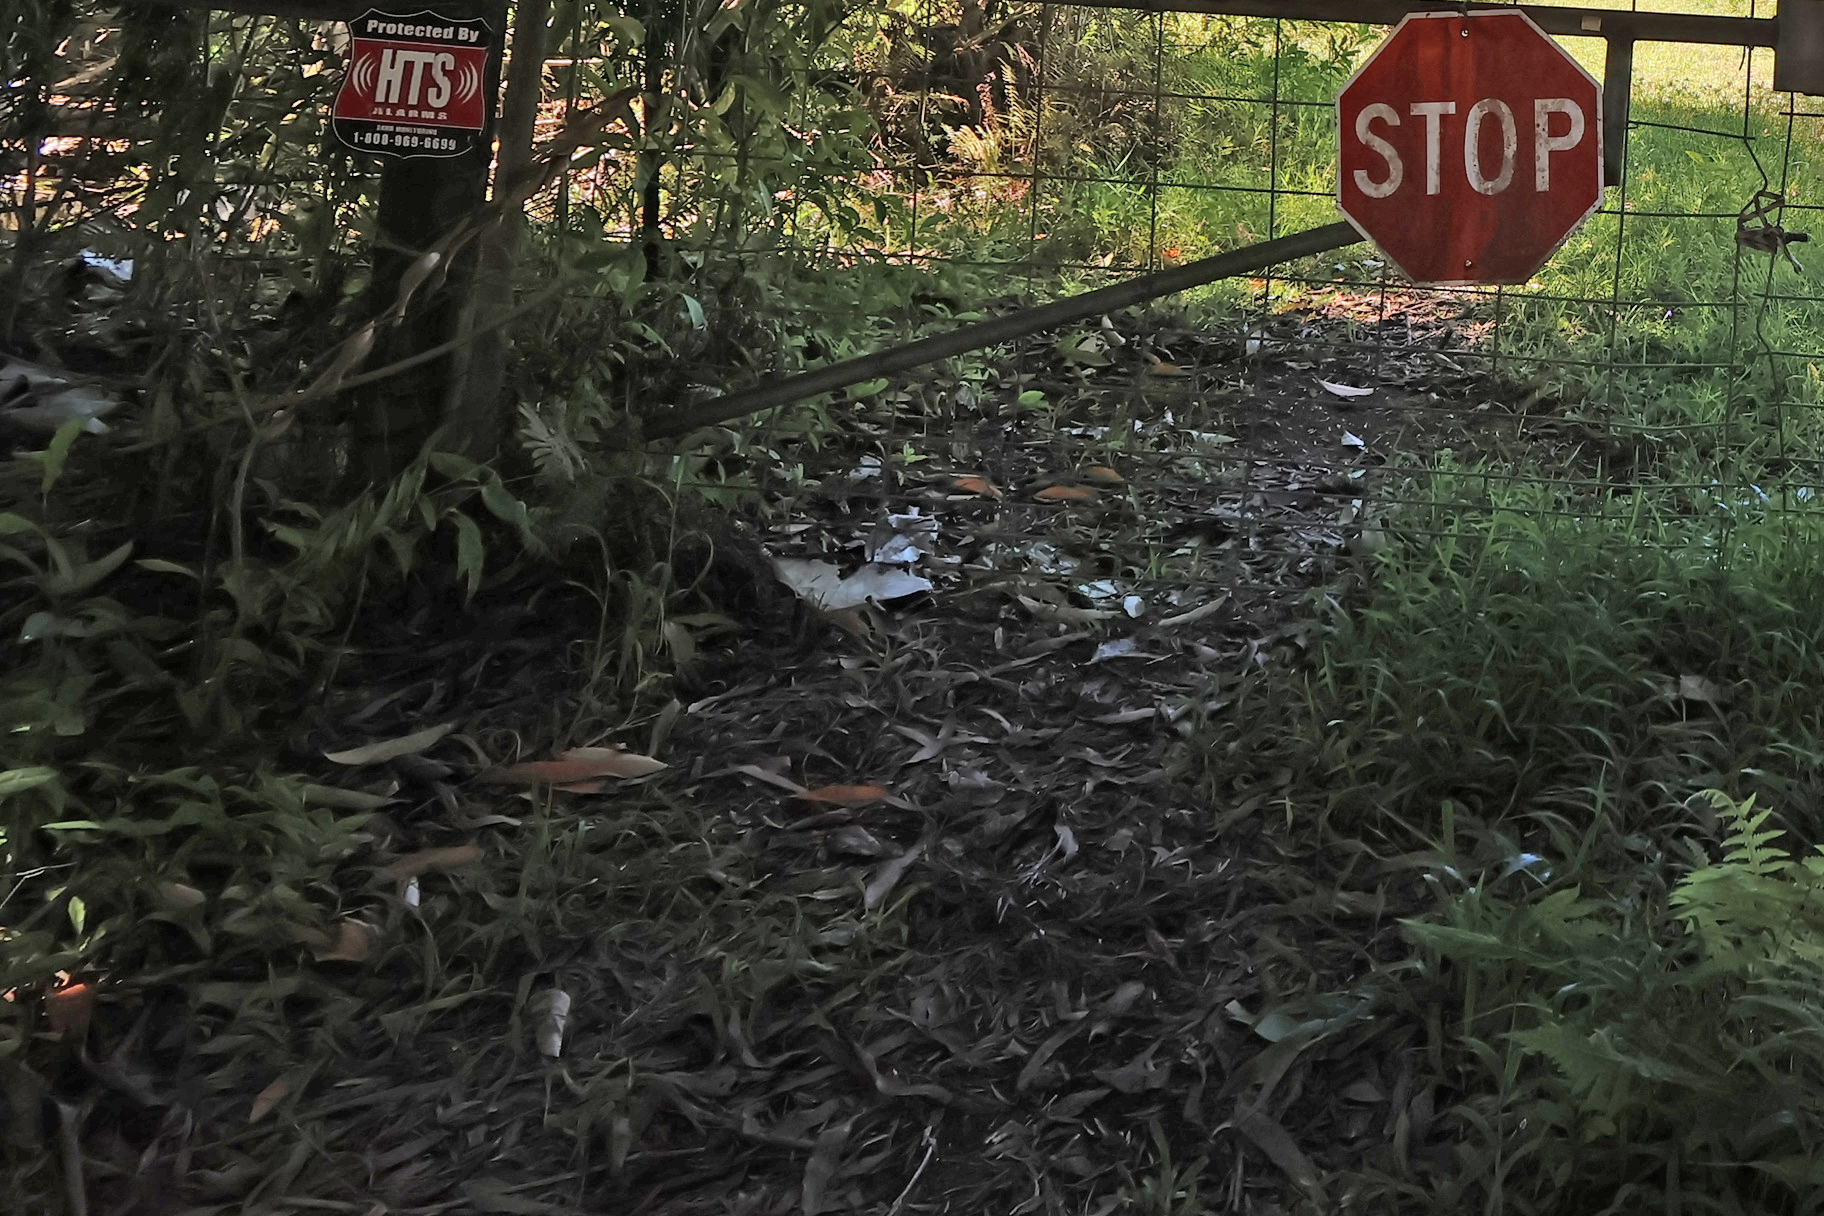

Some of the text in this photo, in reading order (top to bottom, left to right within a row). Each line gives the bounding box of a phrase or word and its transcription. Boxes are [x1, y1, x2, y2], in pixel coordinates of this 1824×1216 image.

[367, 19, 479, 43] Protected By
[374, 48, 455, 108] HTS
[372, 107, 448, 120] ALARMS
[1353, 97, 1585, 199] STOP
